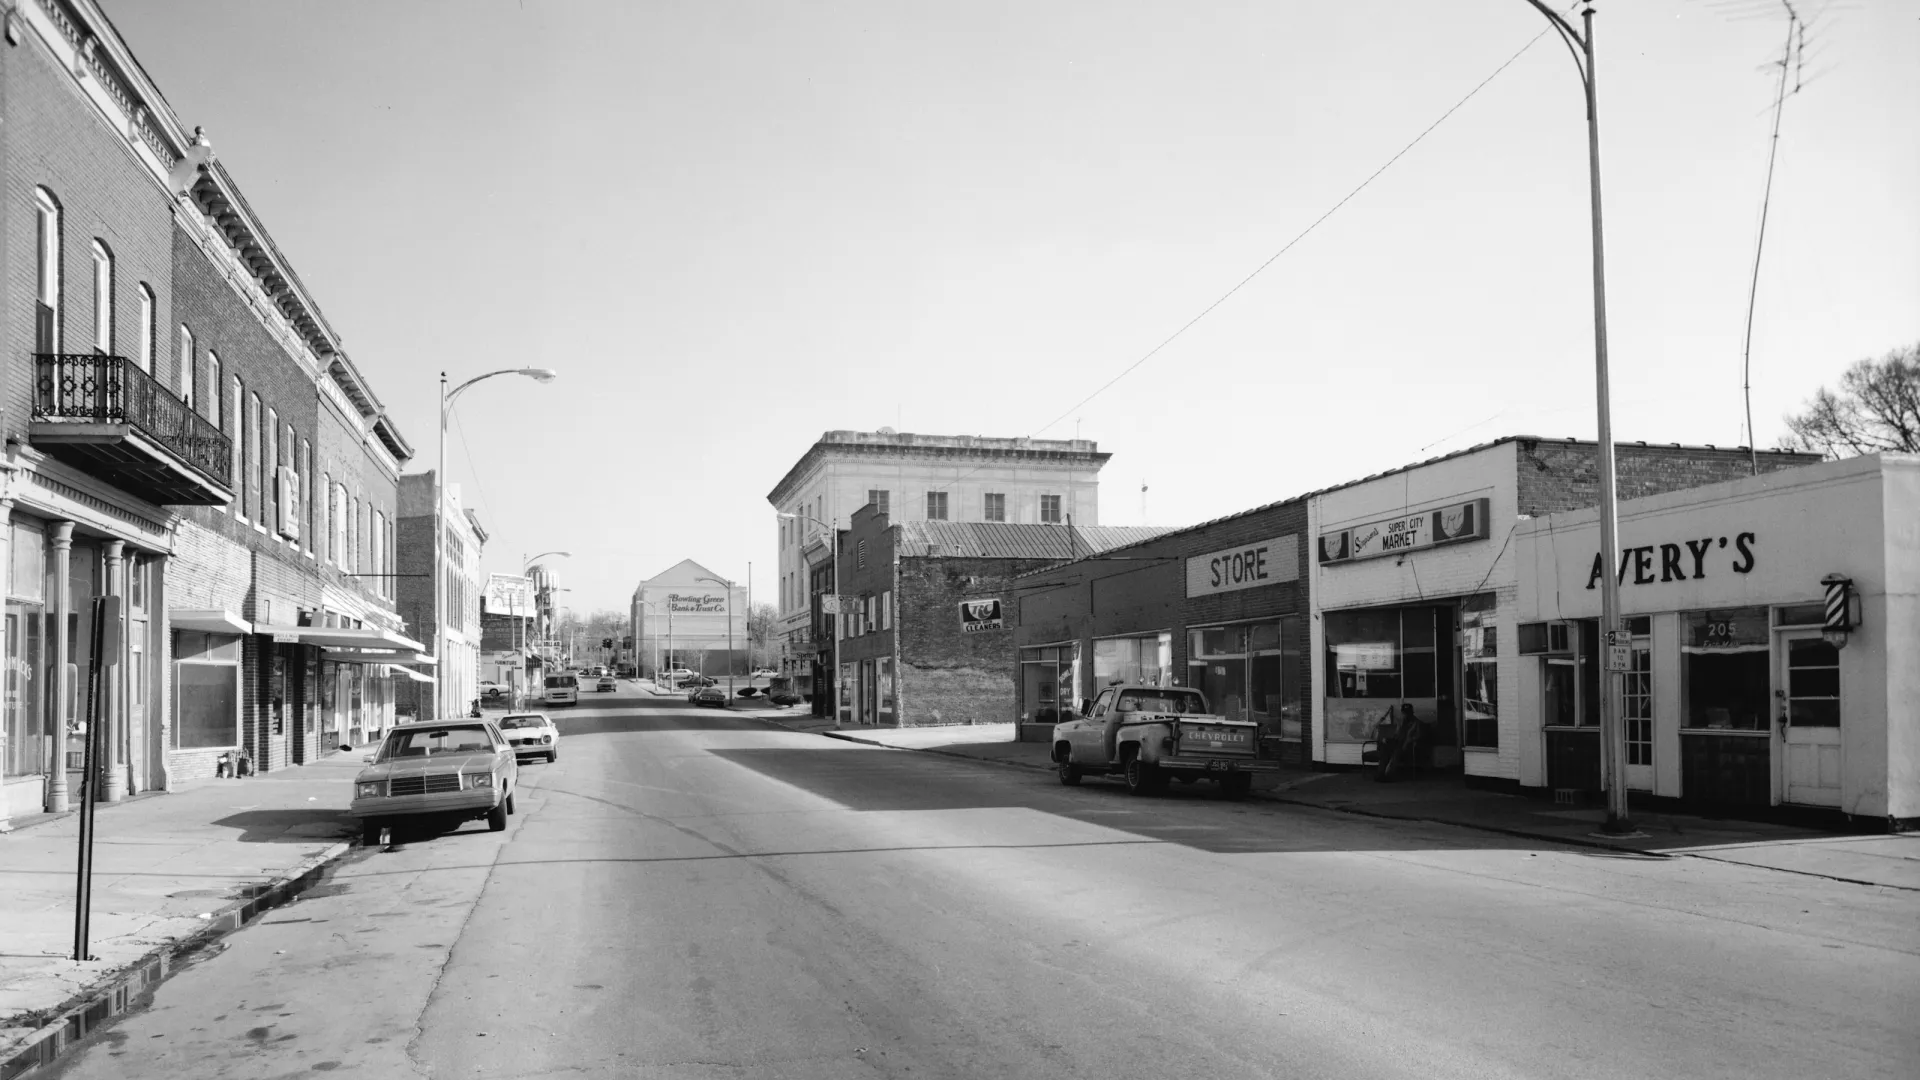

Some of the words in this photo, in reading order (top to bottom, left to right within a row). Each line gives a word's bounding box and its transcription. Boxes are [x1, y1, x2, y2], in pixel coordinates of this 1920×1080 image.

[1388, 521, 1406, 533] SUPER
[1409, 517, 1424, 529] CITY
[1382, 530, 1417, 551] MARKET
[1585, 531, 1756, 590] AVERY'S
[1210, 546, 1268, 587] STORE
[668, 594, 702, 603] Bowling
[703, 595, 725, 604] Green
[667, 603, 690, 612] Bank
[695, 603, 714, 612] Trust
[714, 604, 726, 612] Co.
[966, 622, 1001, 632] CLEANERS
[1708, 622, 1737, 637] 205
[1609, 633, 1616, 644] 2
[1060, 687, 1071, 696] DRY
[1188, 731, 1245, 742] CHEVROLET
